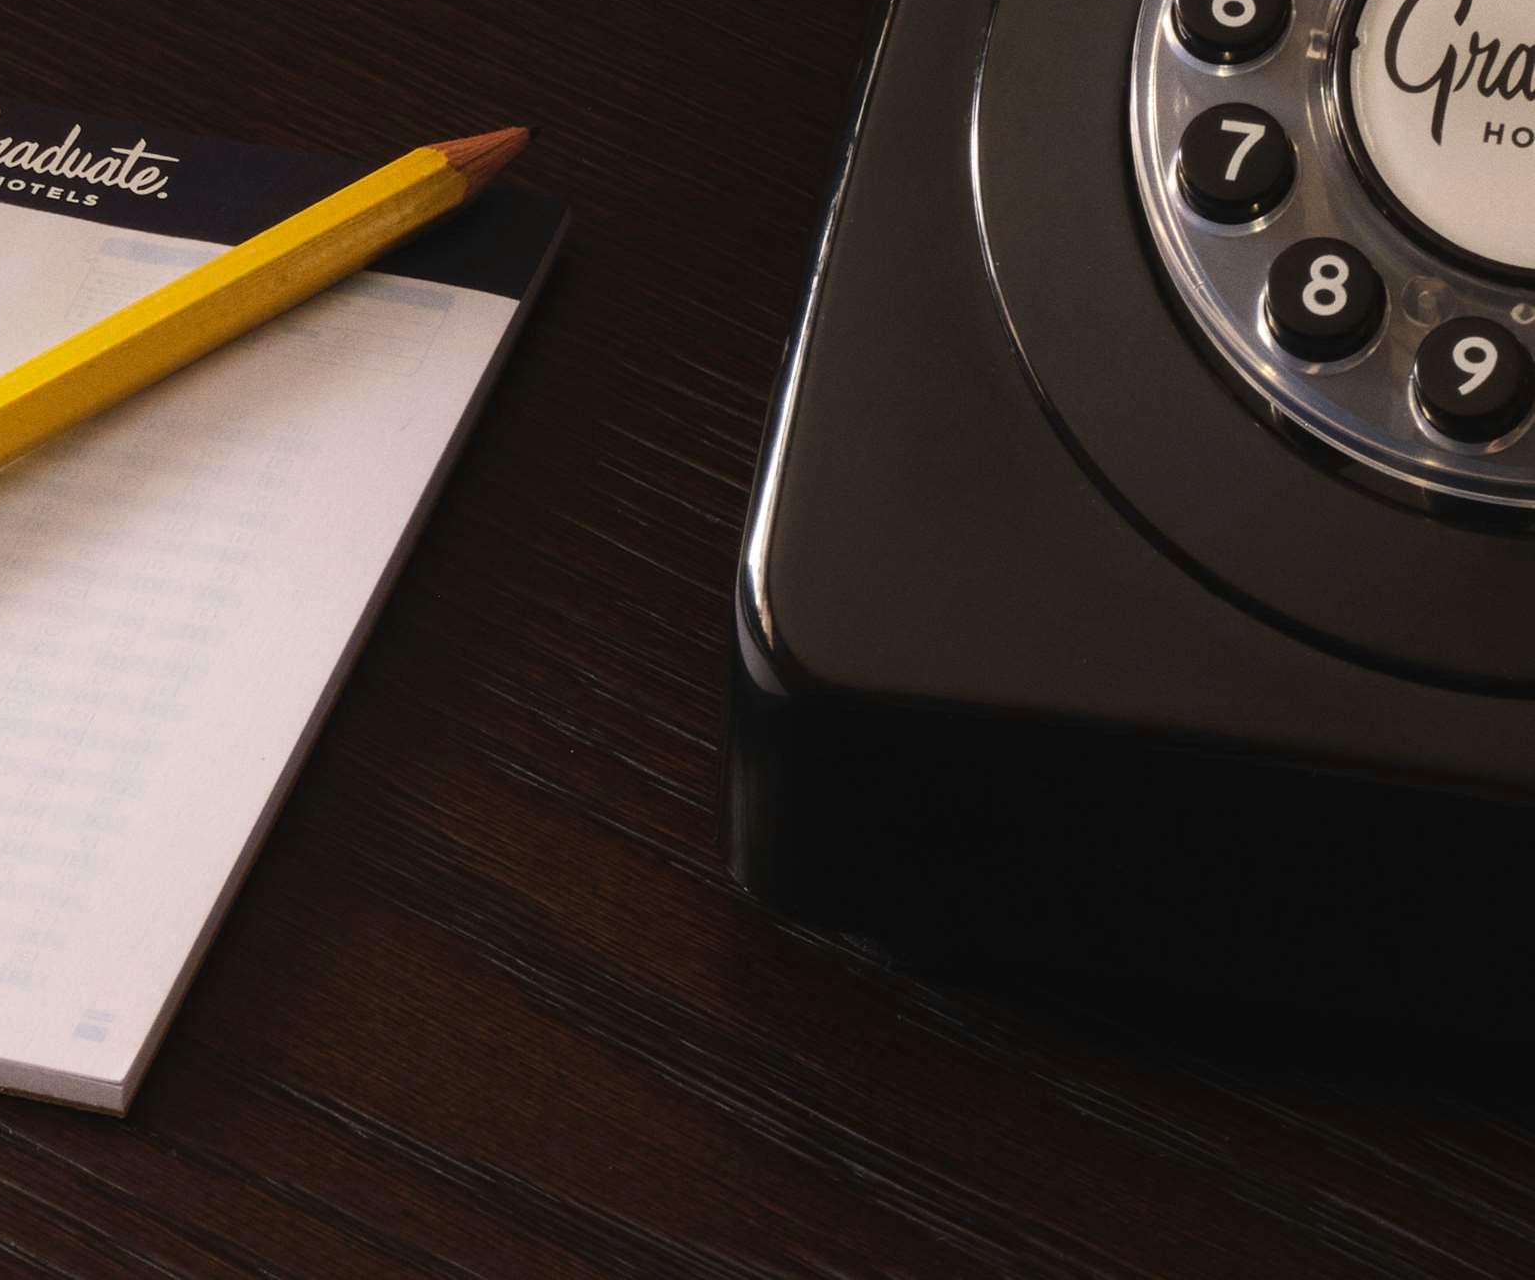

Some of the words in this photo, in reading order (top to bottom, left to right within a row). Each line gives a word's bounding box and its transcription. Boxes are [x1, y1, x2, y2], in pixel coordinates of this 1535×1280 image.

[1220, 120, 1266, 181] 7
[1302, 254, 1350, 316] 8
[1452, 336, 1498, 396] 9
